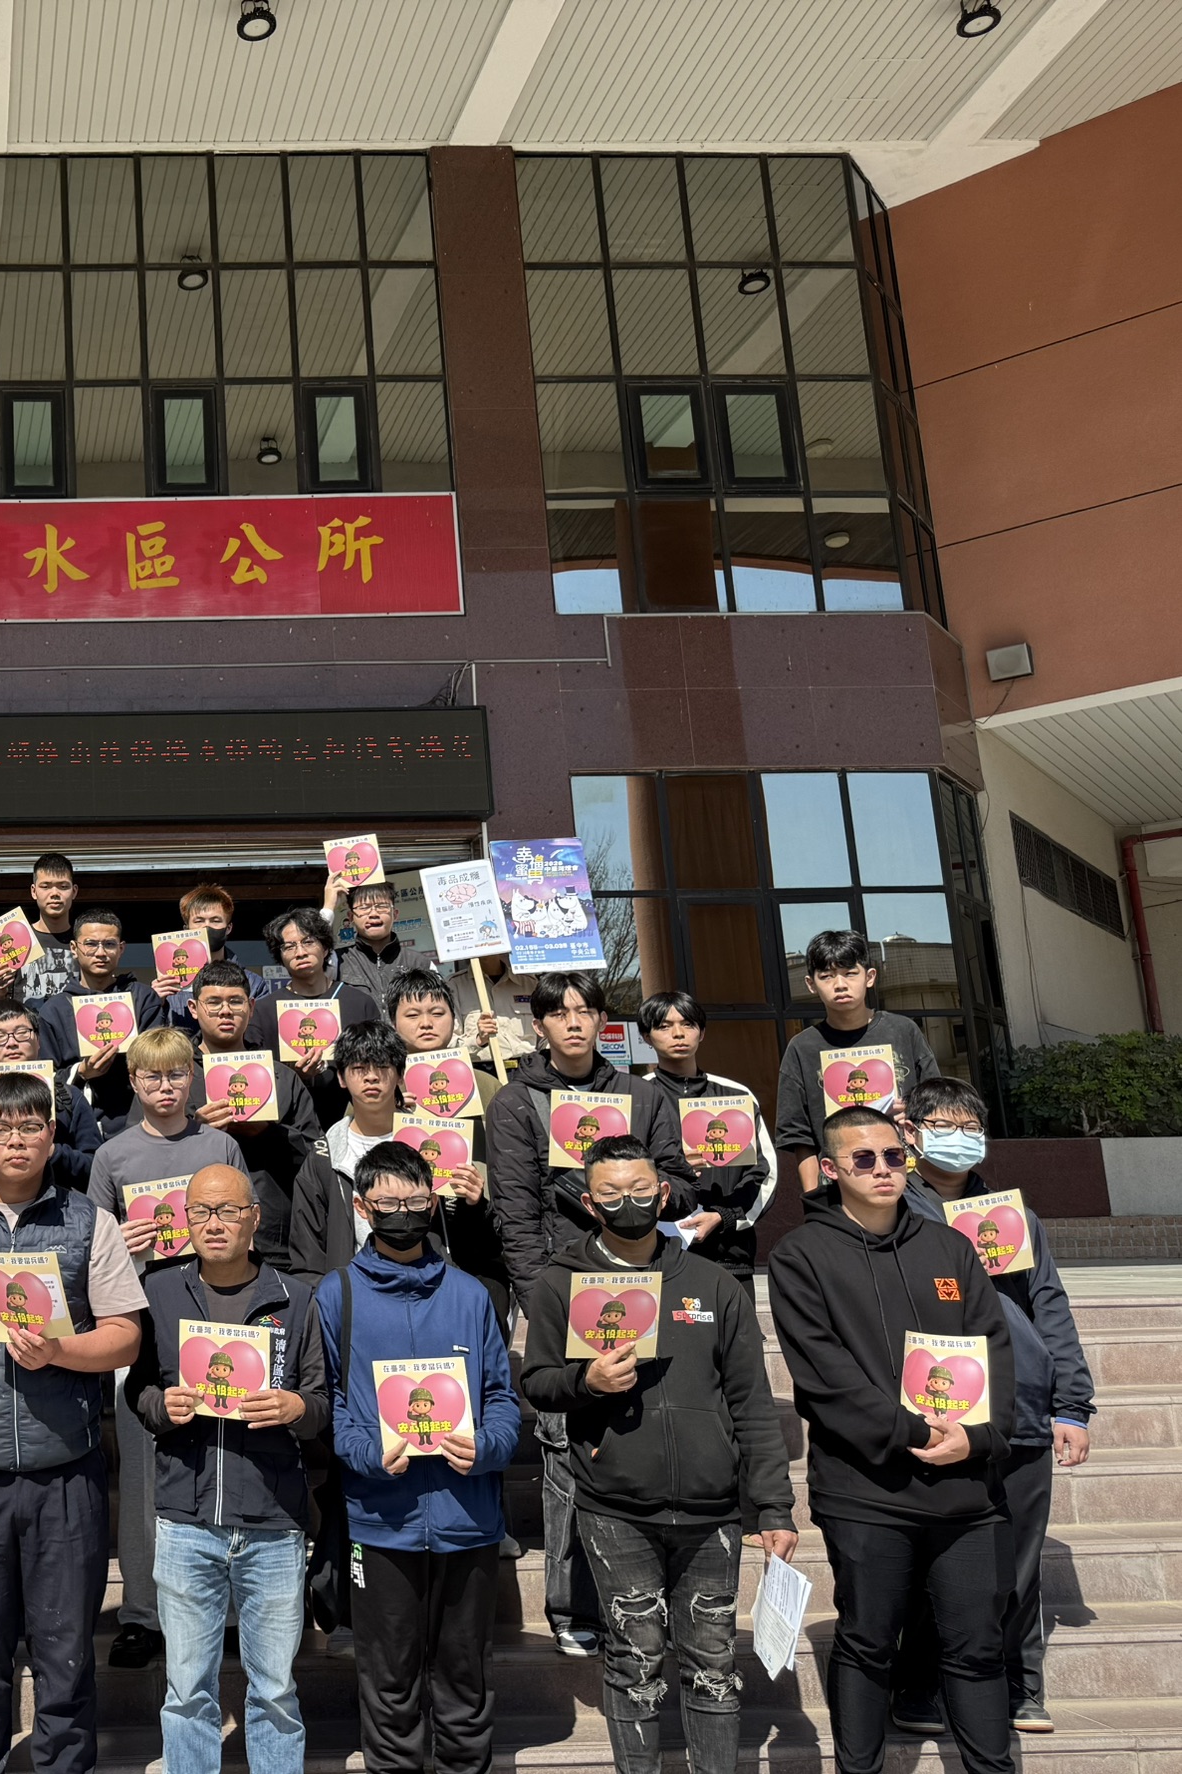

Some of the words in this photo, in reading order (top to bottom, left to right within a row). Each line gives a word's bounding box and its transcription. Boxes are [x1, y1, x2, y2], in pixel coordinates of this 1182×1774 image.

[0, 1311, 45, 1325] 安心役起來
[584, 1329, 638, 1339] 安心役起來
[195, 1382, 248, 1398] 安心役起來
[915, 1393, 970, 1411] 安心役起來
[397, 1420, 452, 1433] 安心役起來
